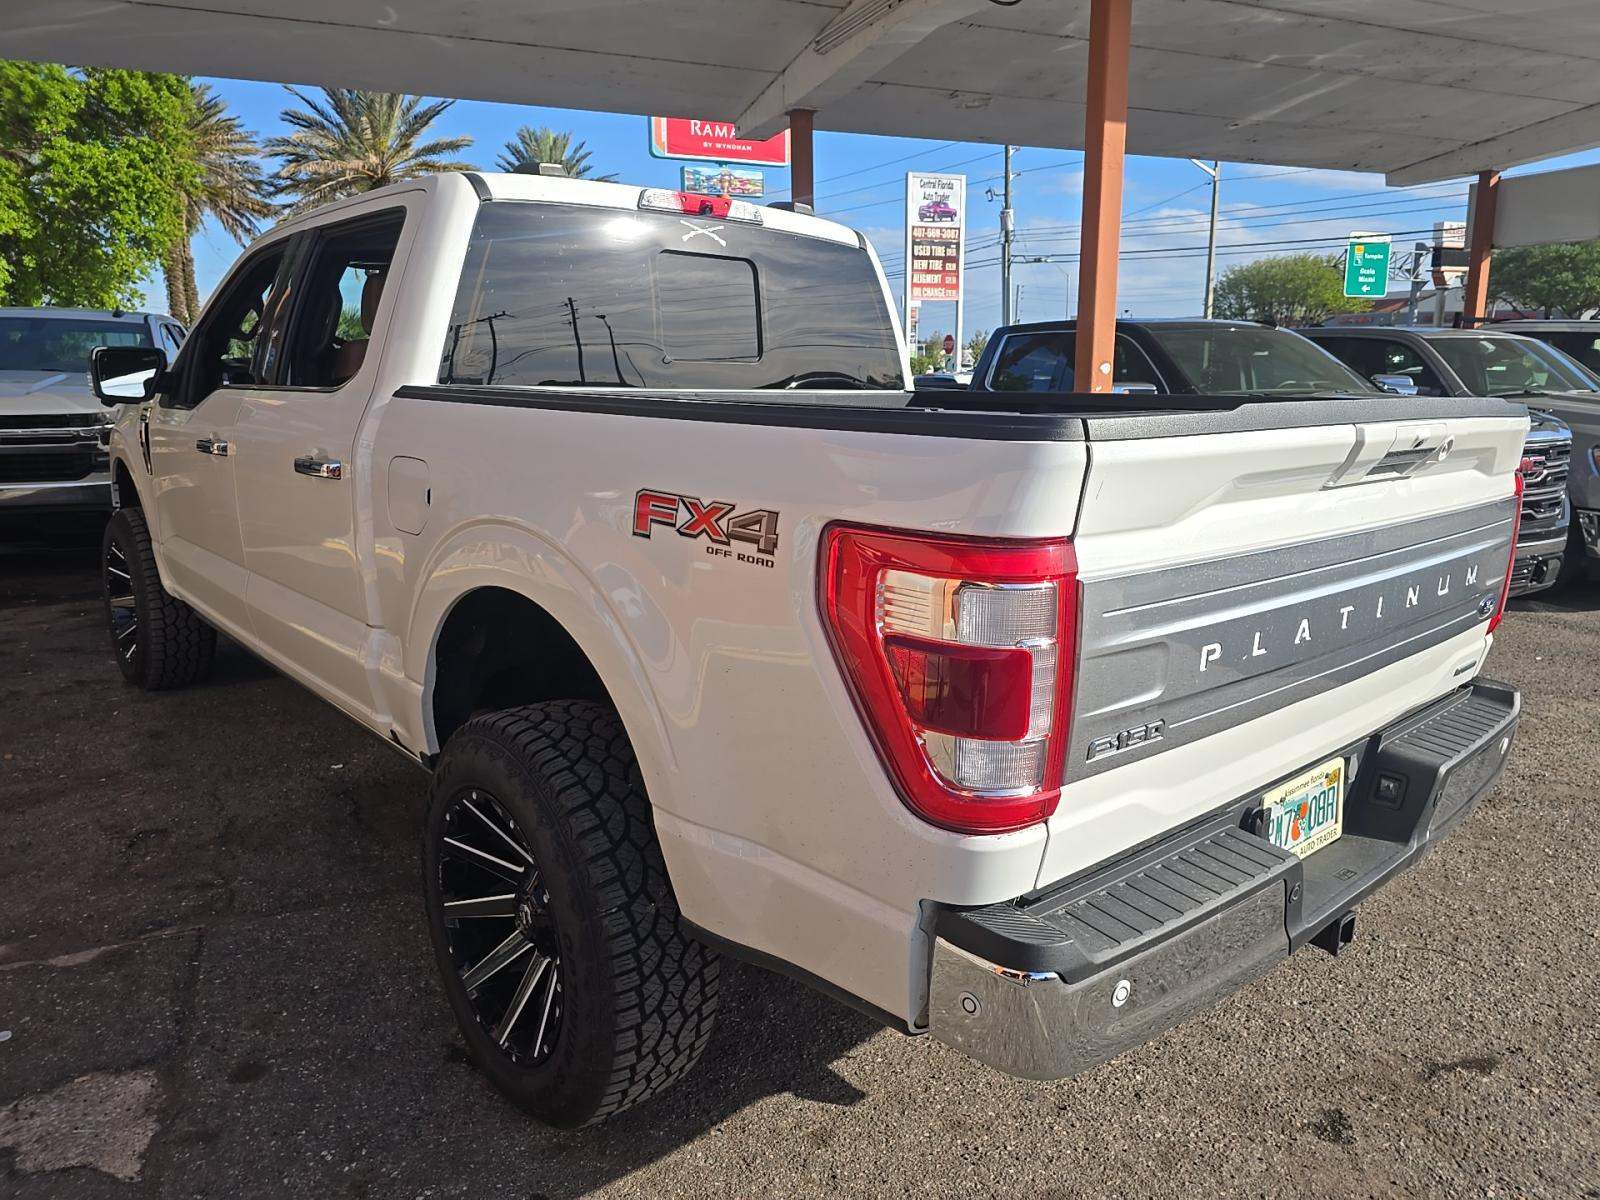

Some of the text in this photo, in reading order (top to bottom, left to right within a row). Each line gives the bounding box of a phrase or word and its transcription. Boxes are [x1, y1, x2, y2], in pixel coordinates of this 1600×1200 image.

[690, 120, 736, 138] RAMA
[716, 142, 752, 152] WYNDHAM
[920, 179, 954, 190] Central Florida
[923, 191, 934, 200] Auto
[914, 245, 931, 256] USED
[931, 245, 946, 256] TIRE
[913, 259, 928, 270] NEW
[928, 259, 943, 270] TIRE
[632, 488, 780, 556] FX4
[706, 546, 775, 569] OFF ROAD
[1199, 564, 1479, 672] PLATINUM
[1086, 717, 1166, 762] F-150
[1299, 840, 1316, 857] AUTO
[1316, 828, 1338, 847] TRADER
